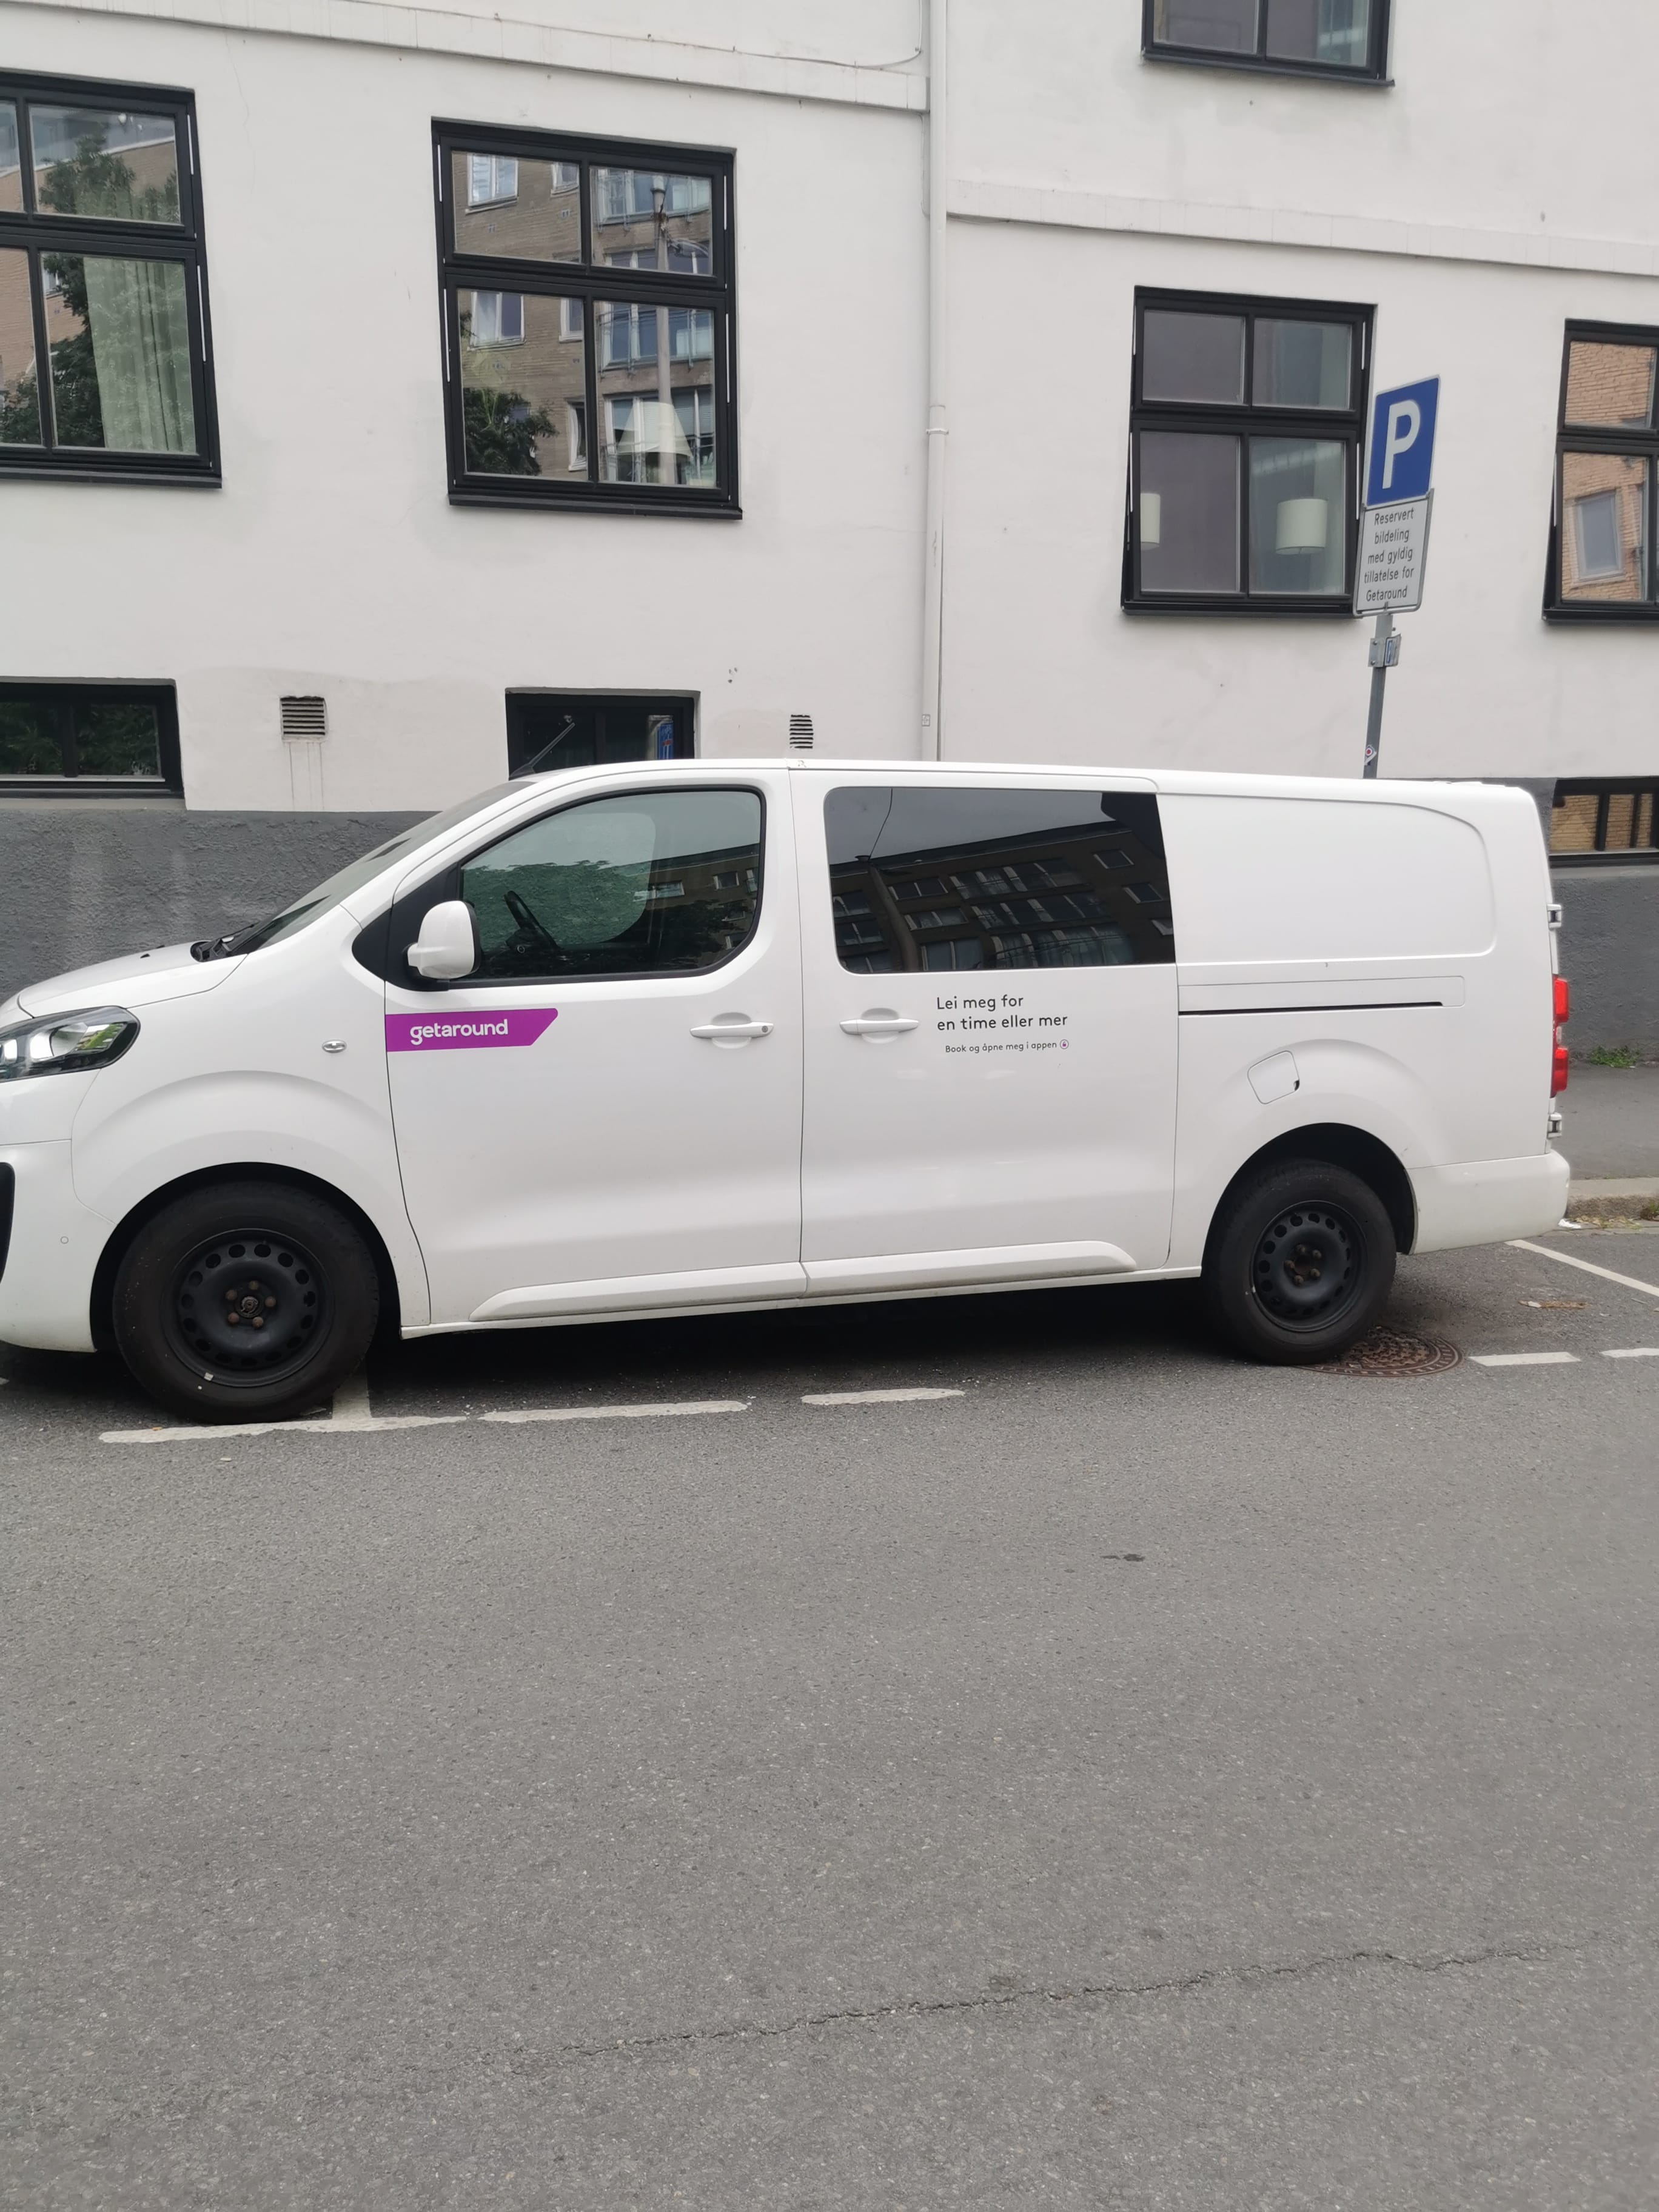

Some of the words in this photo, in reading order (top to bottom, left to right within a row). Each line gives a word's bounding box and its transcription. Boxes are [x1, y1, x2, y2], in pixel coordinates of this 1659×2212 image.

[1382, 400, 1420, 489] P
[1374, 507, 1414, 526] Reservert
[1374, 528, 1409, 545] bildeling
[1367, 550, 1385, 565] med
[1387, 546, 1413, 565] gyldig
[1364, 568, 1398, 583] tillatelse
[1402, 566, 1414, 578] for
[1366, 585, 1407, 602] Getaround
[937, 996, 957, 1010] Lei
[963, 998, 996, 1012] meg
[1000, 994, 1024, 1007] for
[937, 1021, 955, 1030] en
[960, 1016, 996, 1030] time
[1001, 1014, 1034, 1028] eller
[1039, 1016, 1068, 1026] mer
[410, 1019, 508, 1045] getaround
[945, 1044, 967, 1053] Book
[982, 1043, 1003, 1052] åpne
[1005, 1042, 1024, 1051] meg
[1026, 1041, 1029, 1050] i
[1031, 1042, 1057, 1050] appen
